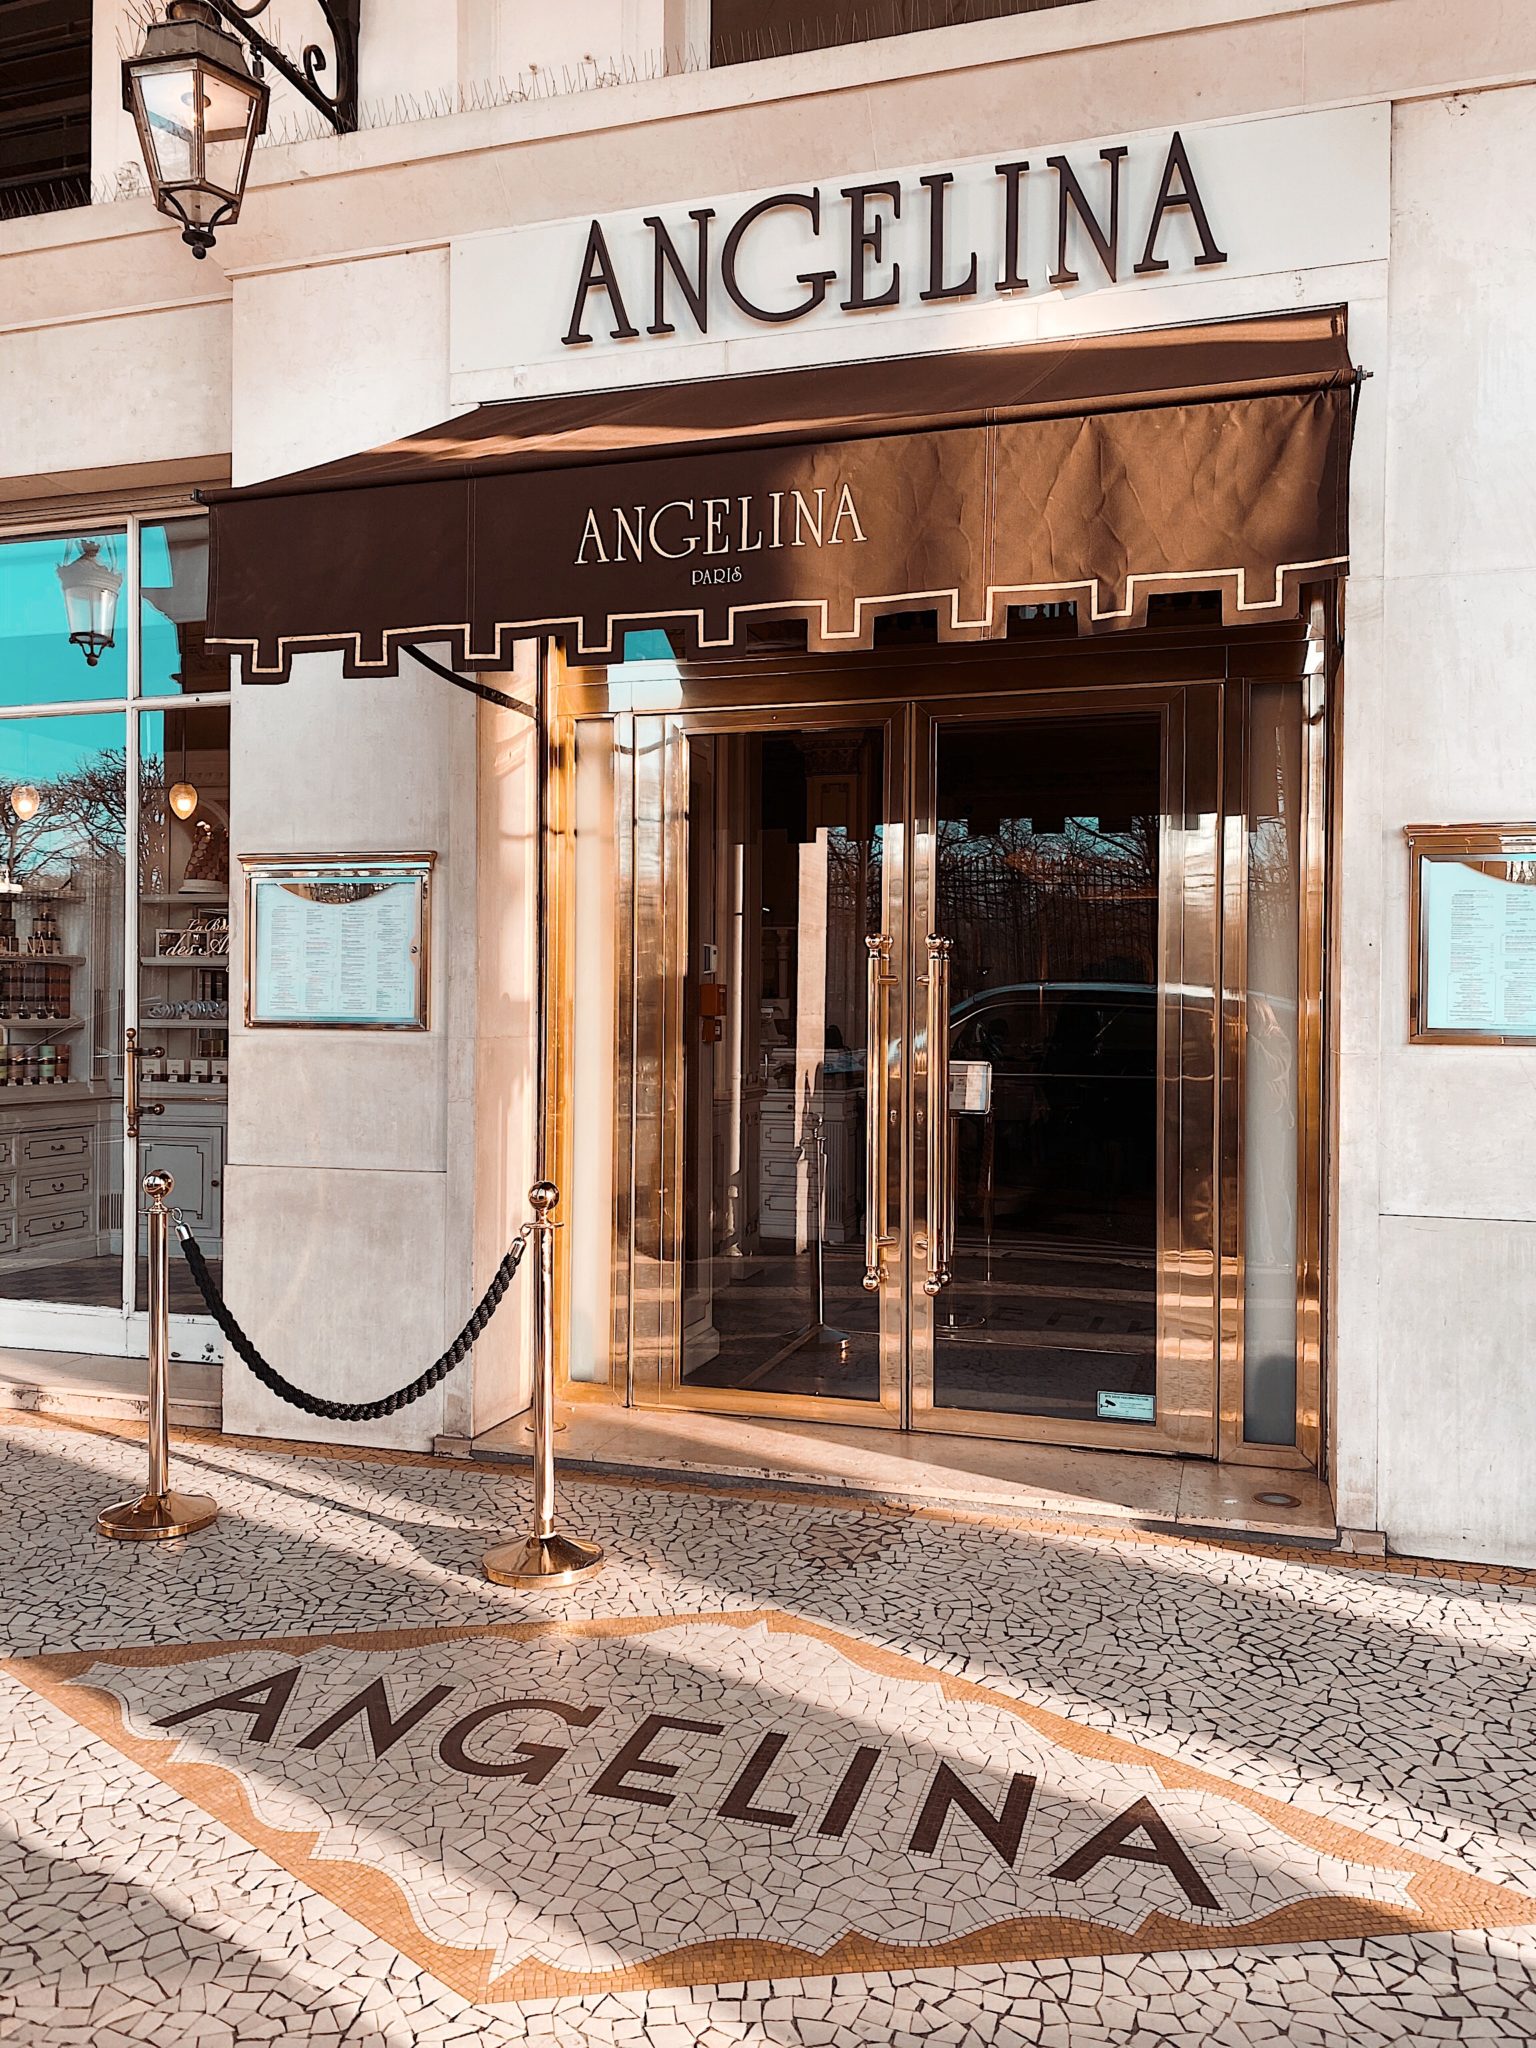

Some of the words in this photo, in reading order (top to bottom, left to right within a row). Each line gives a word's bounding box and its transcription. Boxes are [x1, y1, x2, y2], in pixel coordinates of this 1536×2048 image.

[561, 131, 1228, 345] ANGELINA
[574, 483, 868, 565] ANGELINA
[691, 566, 743, 586] PARIS
[165, 933, 197, 956] des
[183, 918, 203, 932] La
[152, 1666, 1222, 1911] ANGELINA
